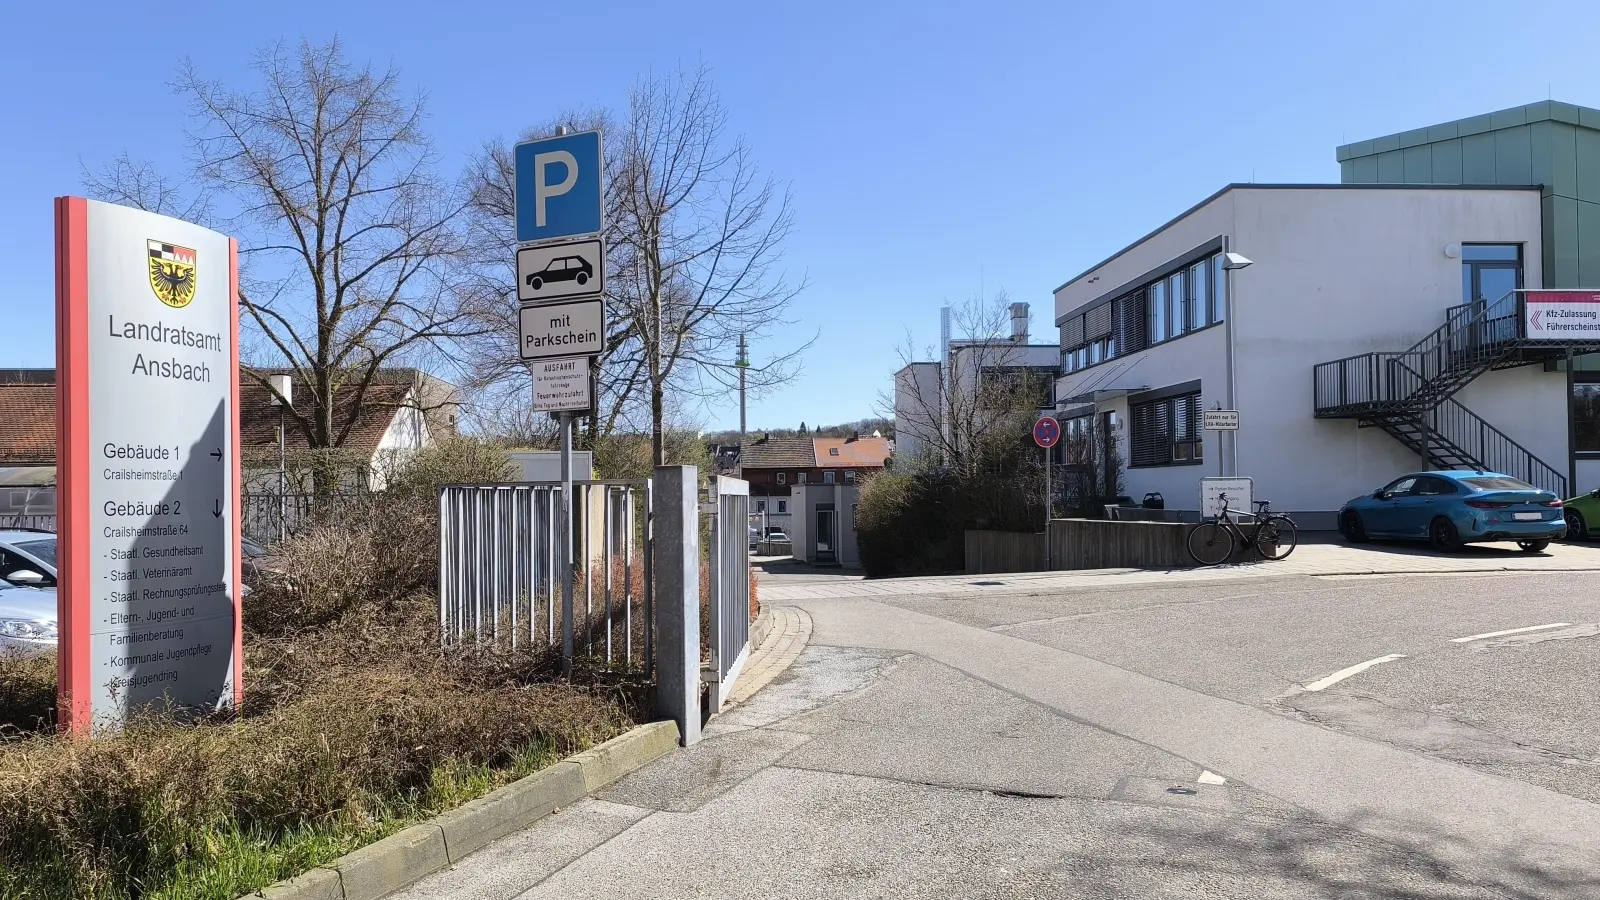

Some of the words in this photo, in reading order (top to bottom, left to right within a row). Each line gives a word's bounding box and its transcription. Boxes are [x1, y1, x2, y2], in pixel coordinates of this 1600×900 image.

[534, 150, 579, 228] P
[550, 314, 571, 328] mit
[1546, 310, 1597, 319] Kfz-Zulassung
[109, 314, 221, 352] Landratsamt
[526, 329, 597, 348] Parkschein
[131, 353, 210, 383] Ansbach
[544, 362, 576, 372] AUSFAHRT
[537, 390, 584, 400] Feuerwehrzufahrt
[103, 442, 170, 460] Gebäude
[174, 446, 179, 460] 1
[103, 468, 178, 480] Crailsheimstraße
[179, 470, 183, 480] 1
[103, 500, 170, 516] Gebäude
[173, 500, 181, 515] 2
[103, 524, 178, 538] Crailsheimstraße
[179, 524, 188, 535] 64
[110, 547, 140, 560] Staatl.
[142, 545, 204, 558] Gesundheitsamt
[110, 569, 140, 581] Staatl.
[142, 565, 193, 579] Veterinäramt
[110, 589, 140, 603] Staatl.
[142, 581, 227, 600] Rechnungsprüfungsstelle
[110, 612, 144, 624] Eltern-,
[146, 606, 179, 622] Jugend-
[181, 605, 195, 616] und
[110, 628, 184, 645] Familienberatung
[110, 650, 164, 667] Kommunale
[166, 643, 212, 660] Jugendpflege
